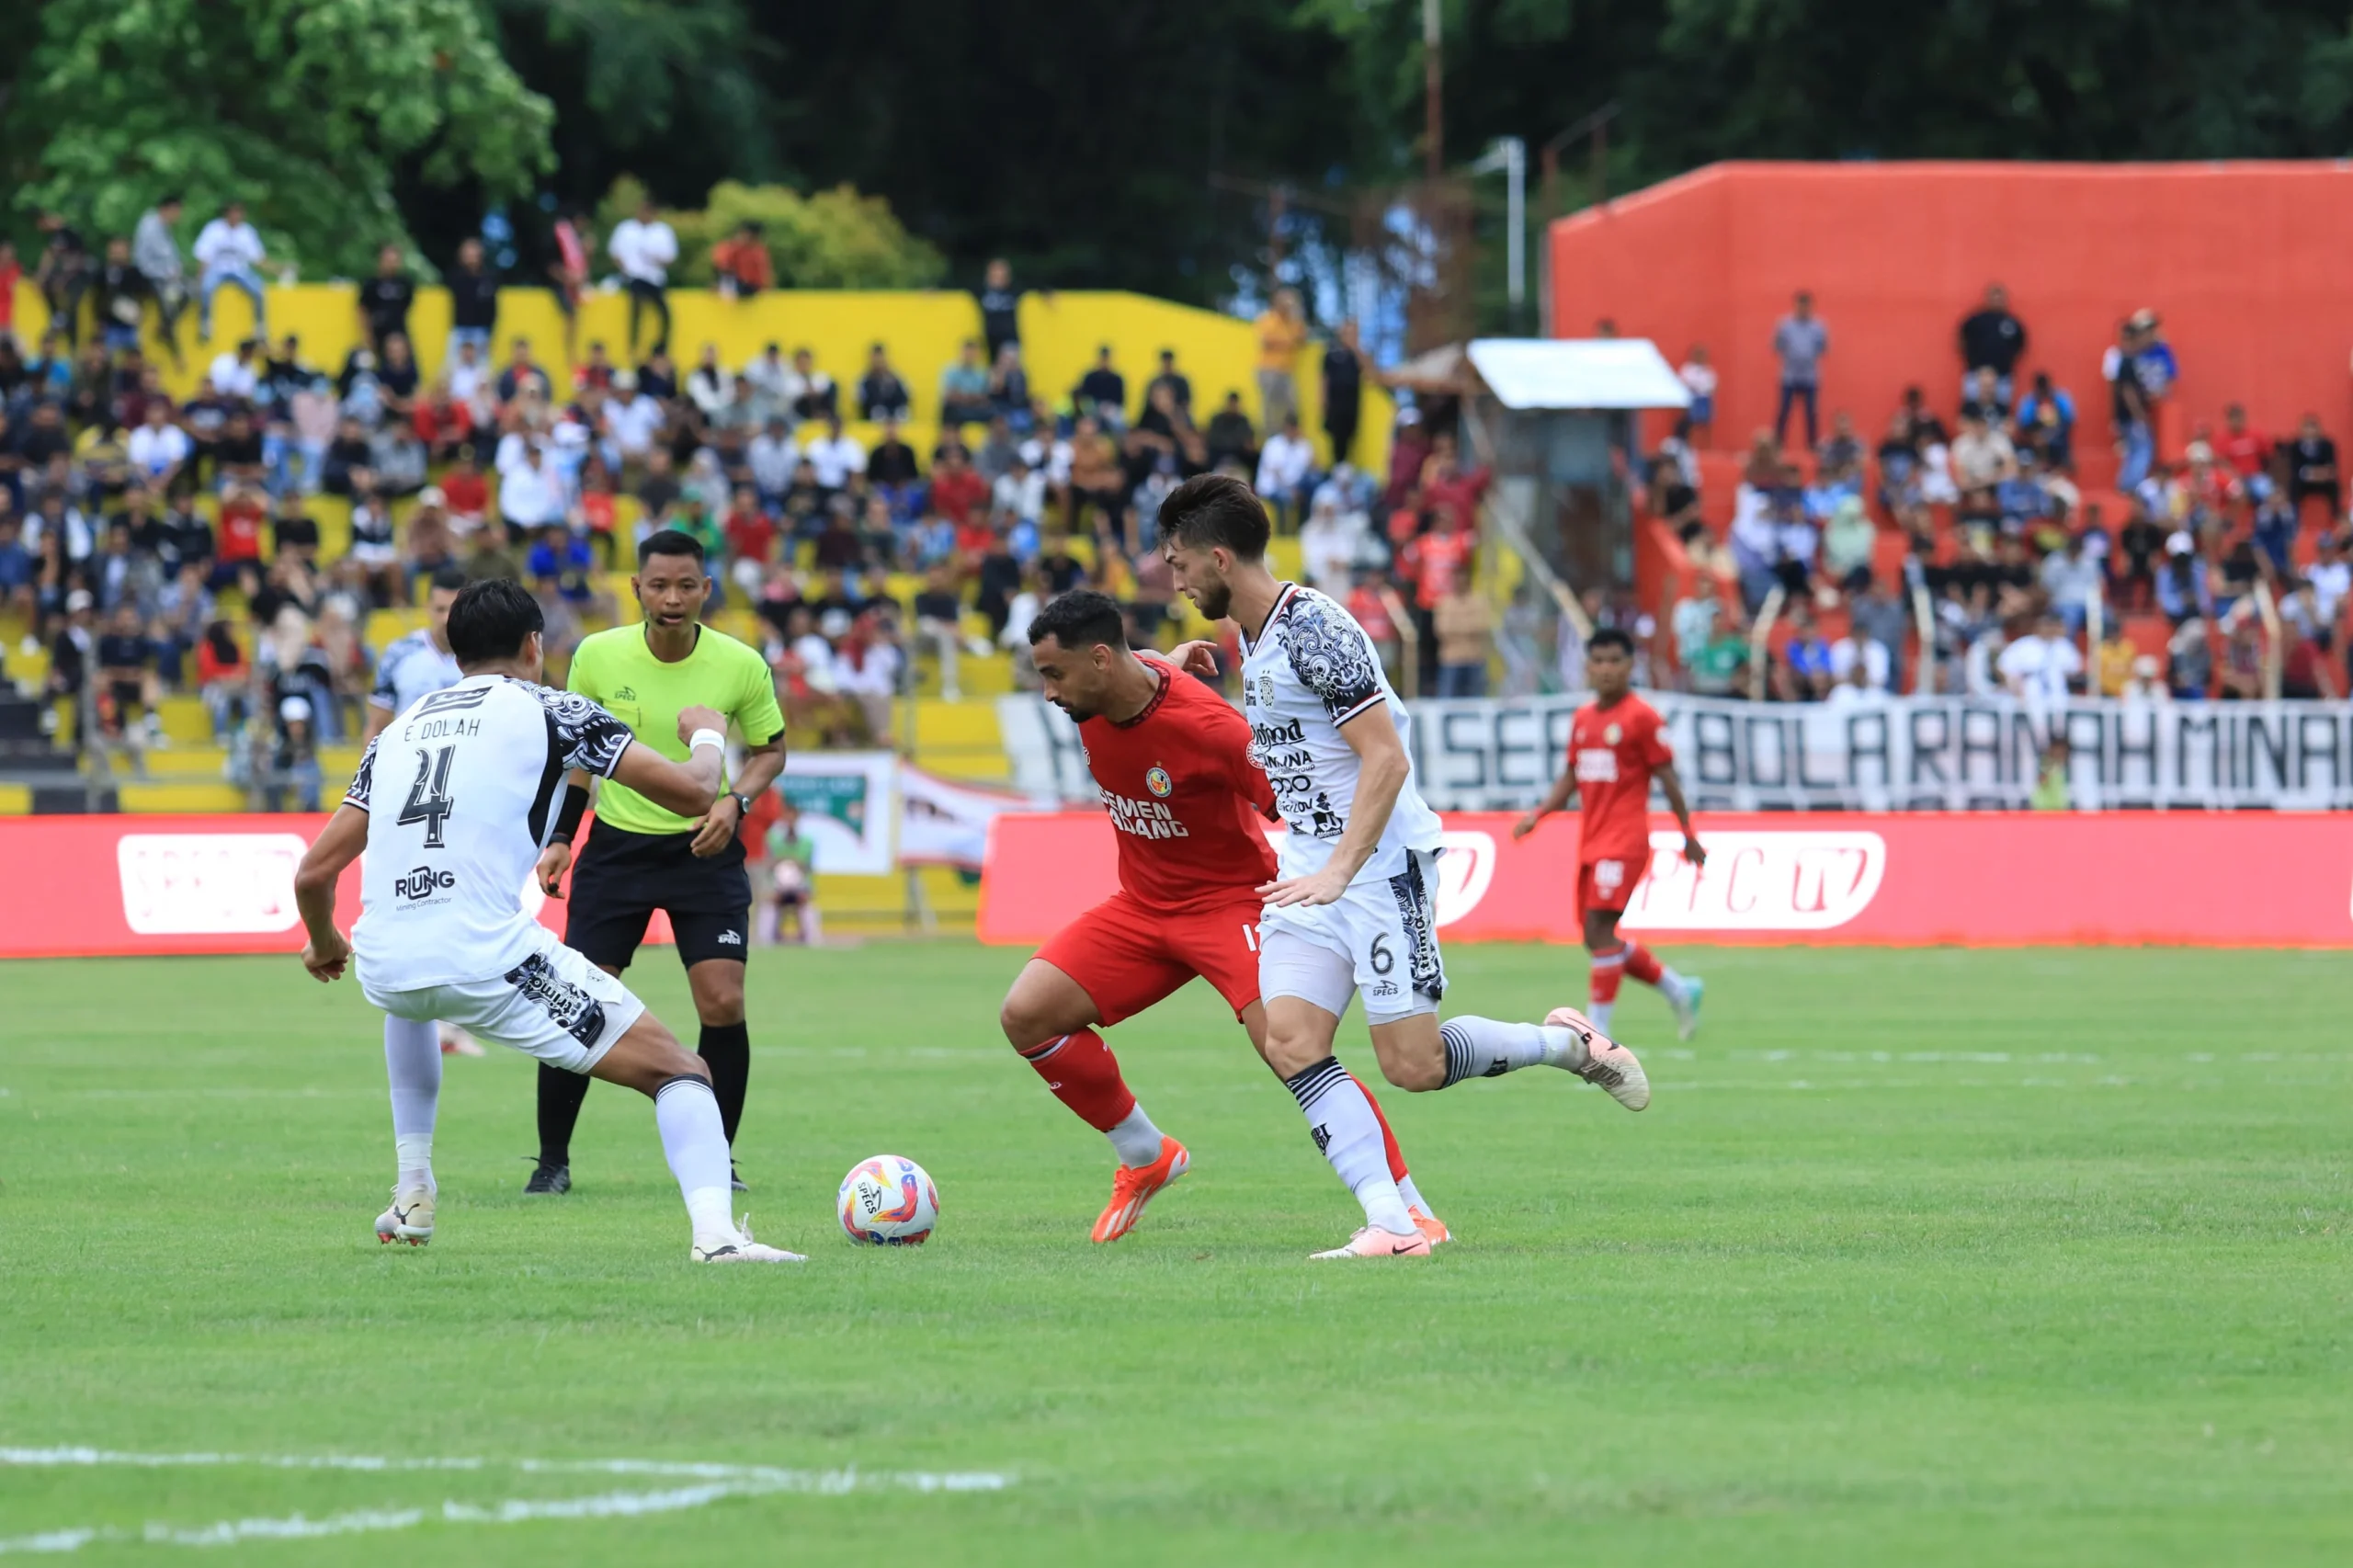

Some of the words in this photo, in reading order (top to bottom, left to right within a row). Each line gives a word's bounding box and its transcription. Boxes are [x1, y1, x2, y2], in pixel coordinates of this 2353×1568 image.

[421, 718, 481, 739] DOLAH
[1695, 711, 1887, 789] BOLA
[1910, 708, 2157, 788] RANAH
[2176, 713, 2353, 789] MINA
[396, 744, 456, 848] 4
[396, 903, 416, 912] Mining
[416, 896, 453, 909] Contractor
[1370, 931, 1394, 976] 6
[1372, 987, 1399, 996] SPECS
[857, 1181, 877, 1215] SPECS
